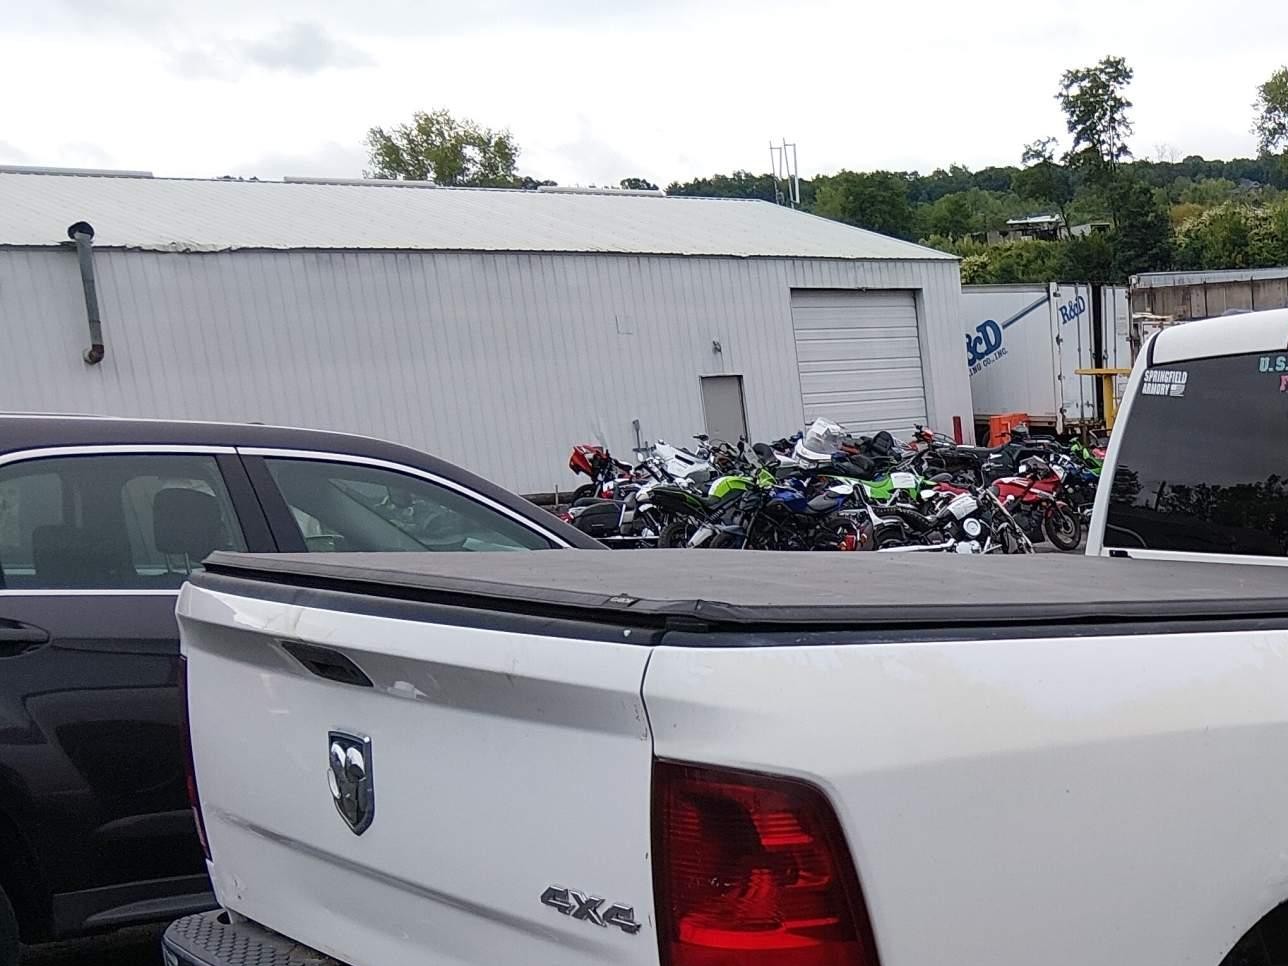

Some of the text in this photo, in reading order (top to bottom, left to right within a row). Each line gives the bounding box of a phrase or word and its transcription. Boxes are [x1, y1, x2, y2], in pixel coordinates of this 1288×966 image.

[1058, 295, 1086, 325] R&D
[965, 319, 1002, 367] &D
[1143, 369, 1188, 384] SPRINGFIELD
[1142, 382, 1170, 396] ARMORY
